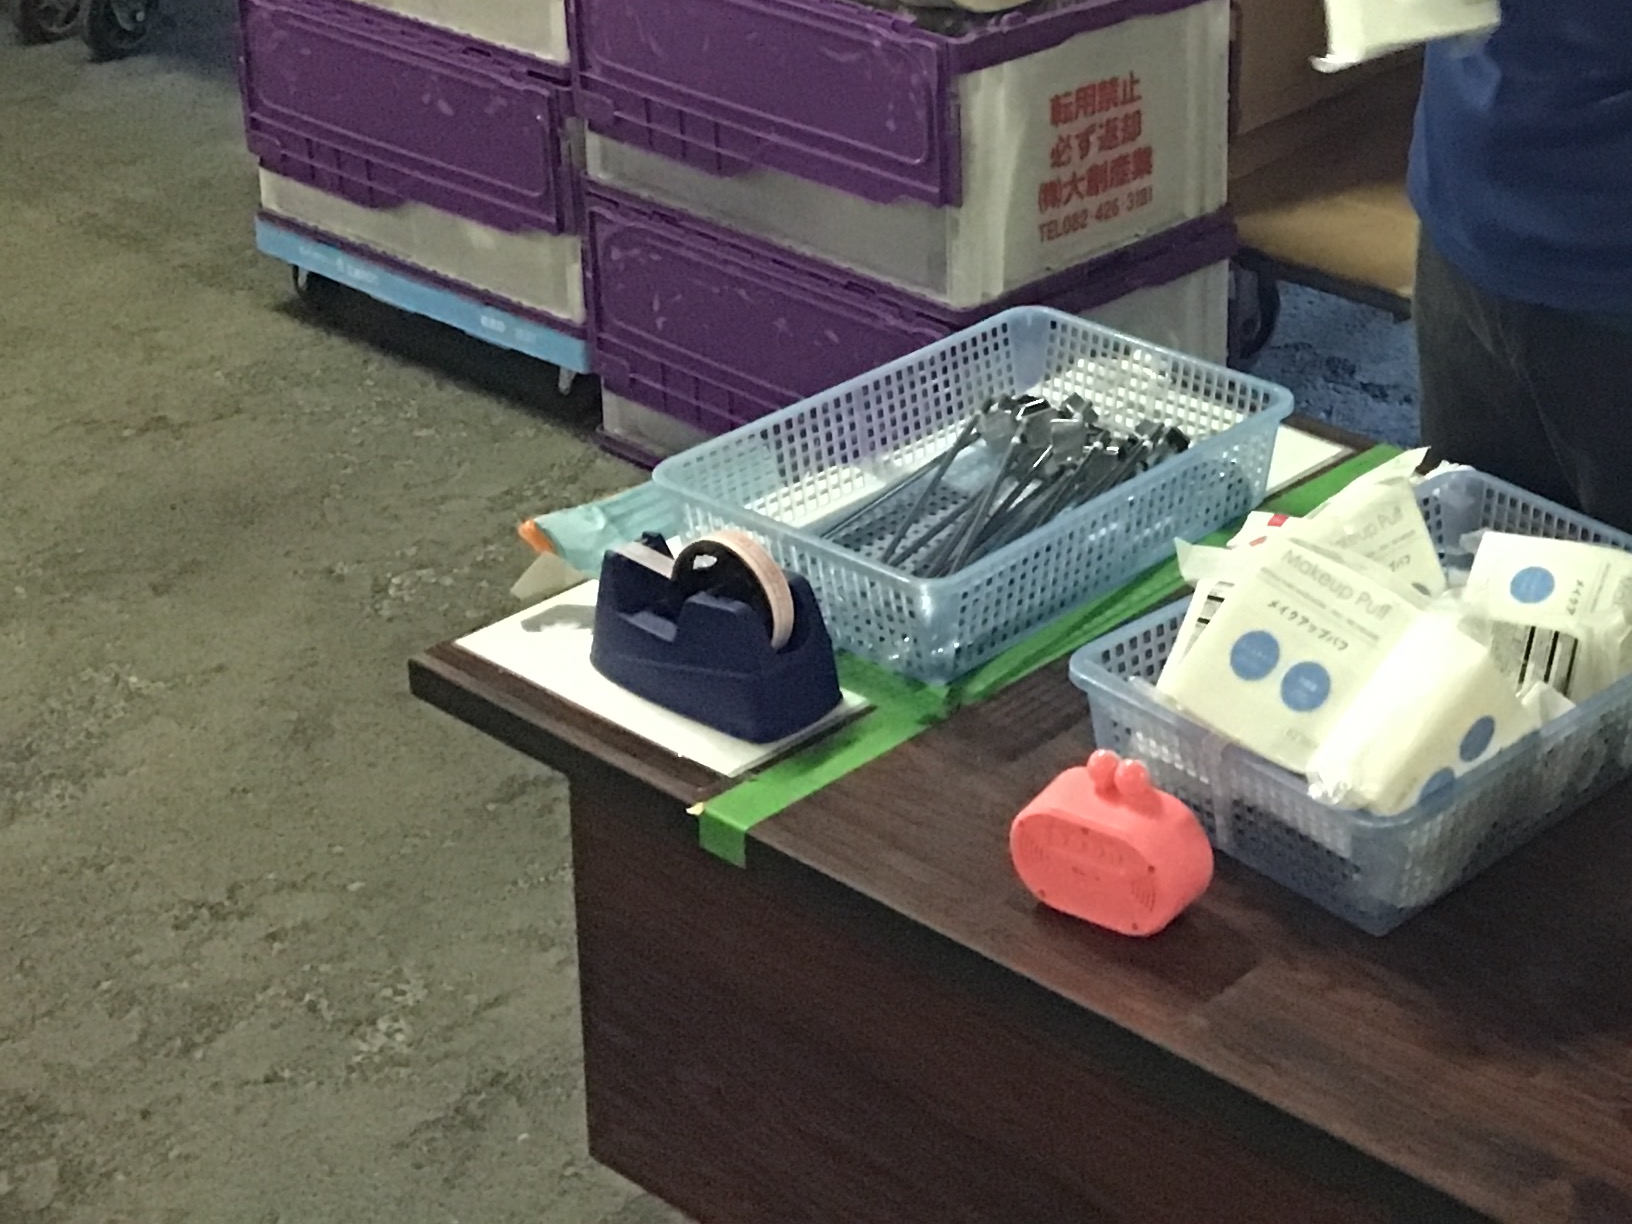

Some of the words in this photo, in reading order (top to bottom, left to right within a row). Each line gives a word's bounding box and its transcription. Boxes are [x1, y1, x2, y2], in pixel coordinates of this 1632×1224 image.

[1050, 70, 1142, 127] 転用禁止
[1050, 109, 1142, 168] 必ず返却
[1281, 549, 1354, 600] Makeup
[1356, 590, 1393, 621] Puff
[1267, 600, 1349, 651] メイクアップパフ
